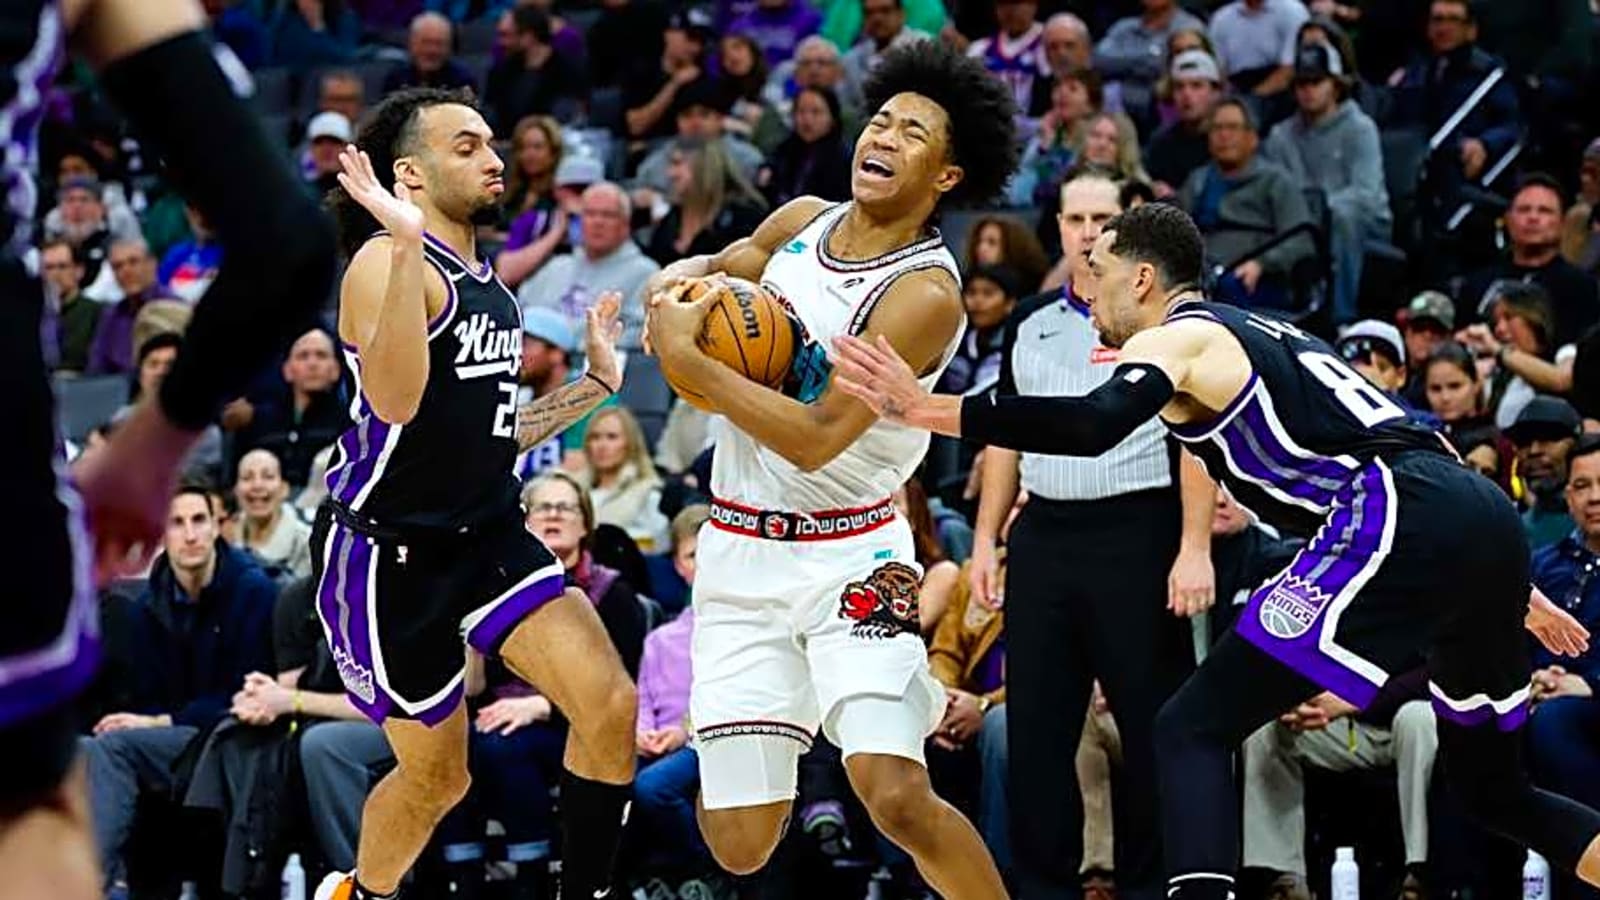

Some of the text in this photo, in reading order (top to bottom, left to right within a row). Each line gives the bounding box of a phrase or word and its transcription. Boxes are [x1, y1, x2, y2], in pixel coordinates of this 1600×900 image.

[453, 313, 522, 376] King
[492, 382, 519, 440] 2
[1297, 351, 1406, 428] 8
[1268, 592, 1315, 625] KINGS
